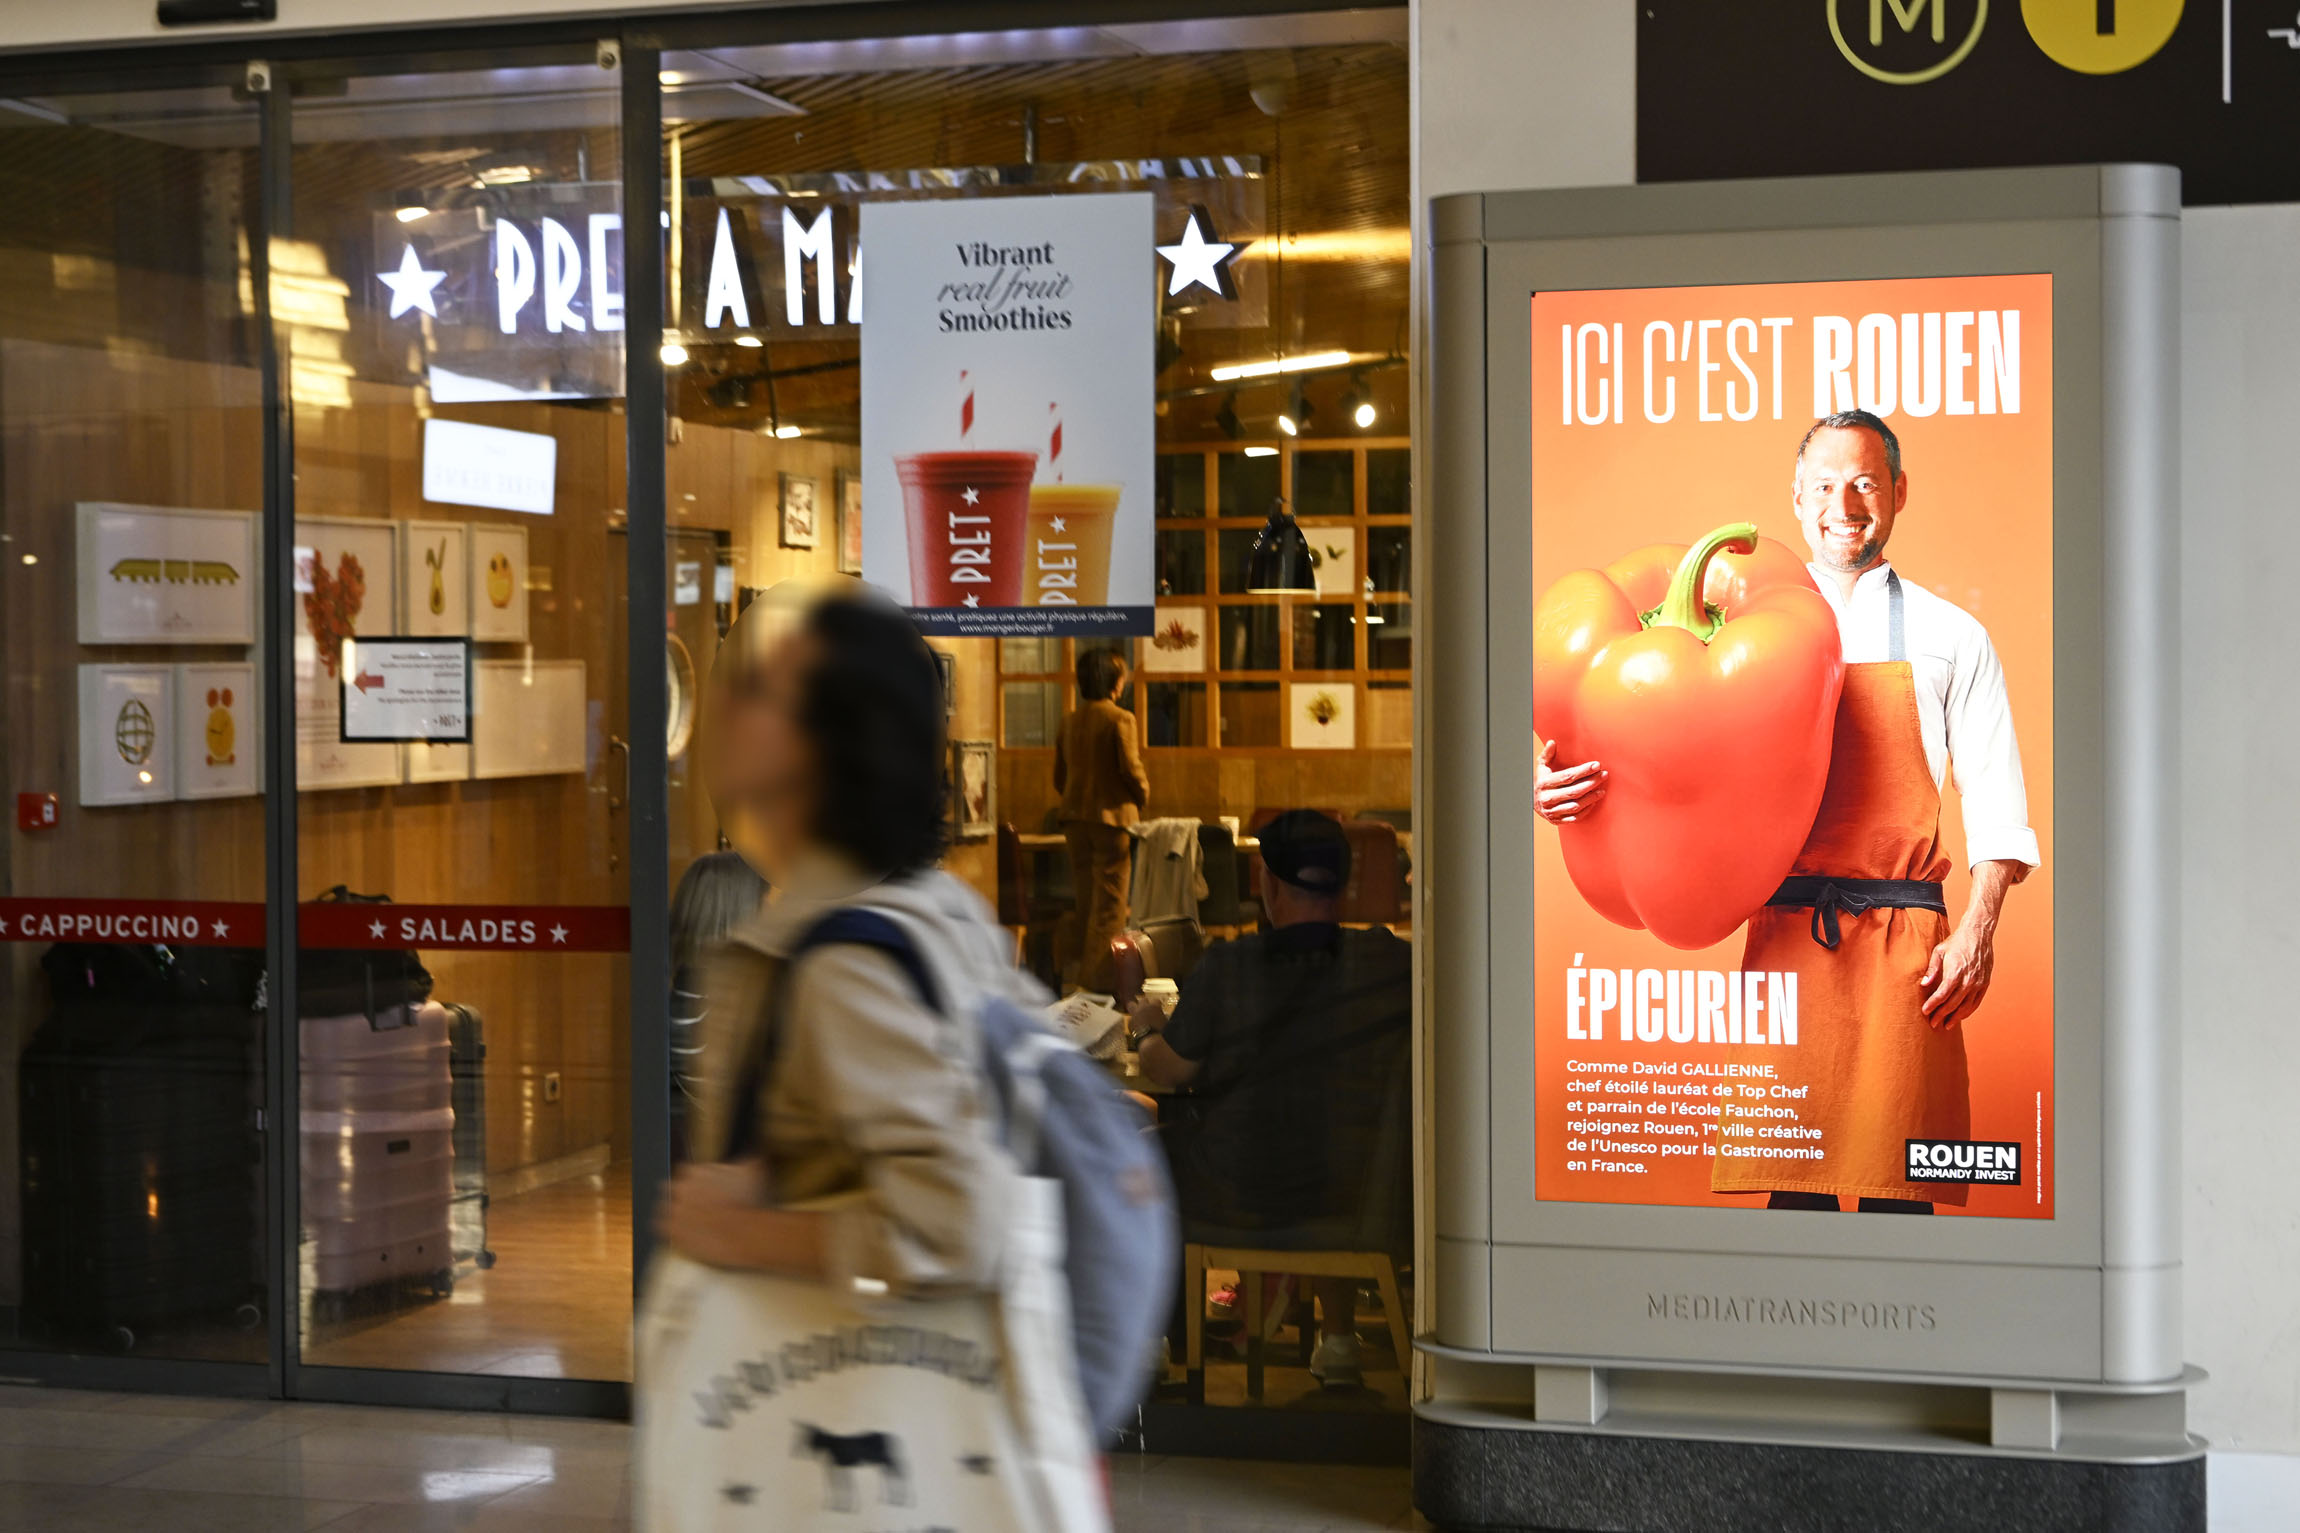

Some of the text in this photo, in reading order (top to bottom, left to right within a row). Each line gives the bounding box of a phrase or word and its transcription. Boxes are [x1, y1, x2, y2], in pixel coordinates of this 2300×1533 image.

[956, 241, 1055, 267] Vibrant
[496, 213, 671, 335] PRE
[704, 206, 751, 329] A
[937, 266, 1073, 313] real fruit
[938, 304, 1073, 333] Smoothies
[1562, 309, 2021, 426] ICI C'EST ROUEN
[949, 511, 991, 583] PRET
[1037, 538, 1077, 605] PRET
[959, 623, 1054, 635] www.mangerbouger.fr
[998, 612, 1015, 621] une
[1048, 611, 1087, 623] physique
[20, 913, 200, 939] CAPPUCCINO
[400, 918, 536, 944] SALADES
[1567, 952, 1798, 1045] ÉPICURIEN
[1567, 1060, 1779, 1080] Comme David GALLIENNE,
[1567, 1079, 1809, 1100] chef étoilé lauréat de Top Chef
[1567, 1101, 1799, 1121] et parrain de l'école Fauchon,
[1567, 1119, 1640, 1137] rejoignez
[1644, 1121, 1699, 1138] Rouen,
[1722, 1123, 1754, 1137] ville
[1758, 1125, 1823, 1140] créative
[1567, 1138, 1825, 1160] de l'Unesco pour la Gastronomie
[1909, 1143, 2017, 1169] ROUEN
[1567, 1159, 1648, 1174] en France.
[1910, 1167, 2016, 1181] NORMANDY INVEST
[1647, 1293, 1937, 1331] MEDIATRANSPORTS
